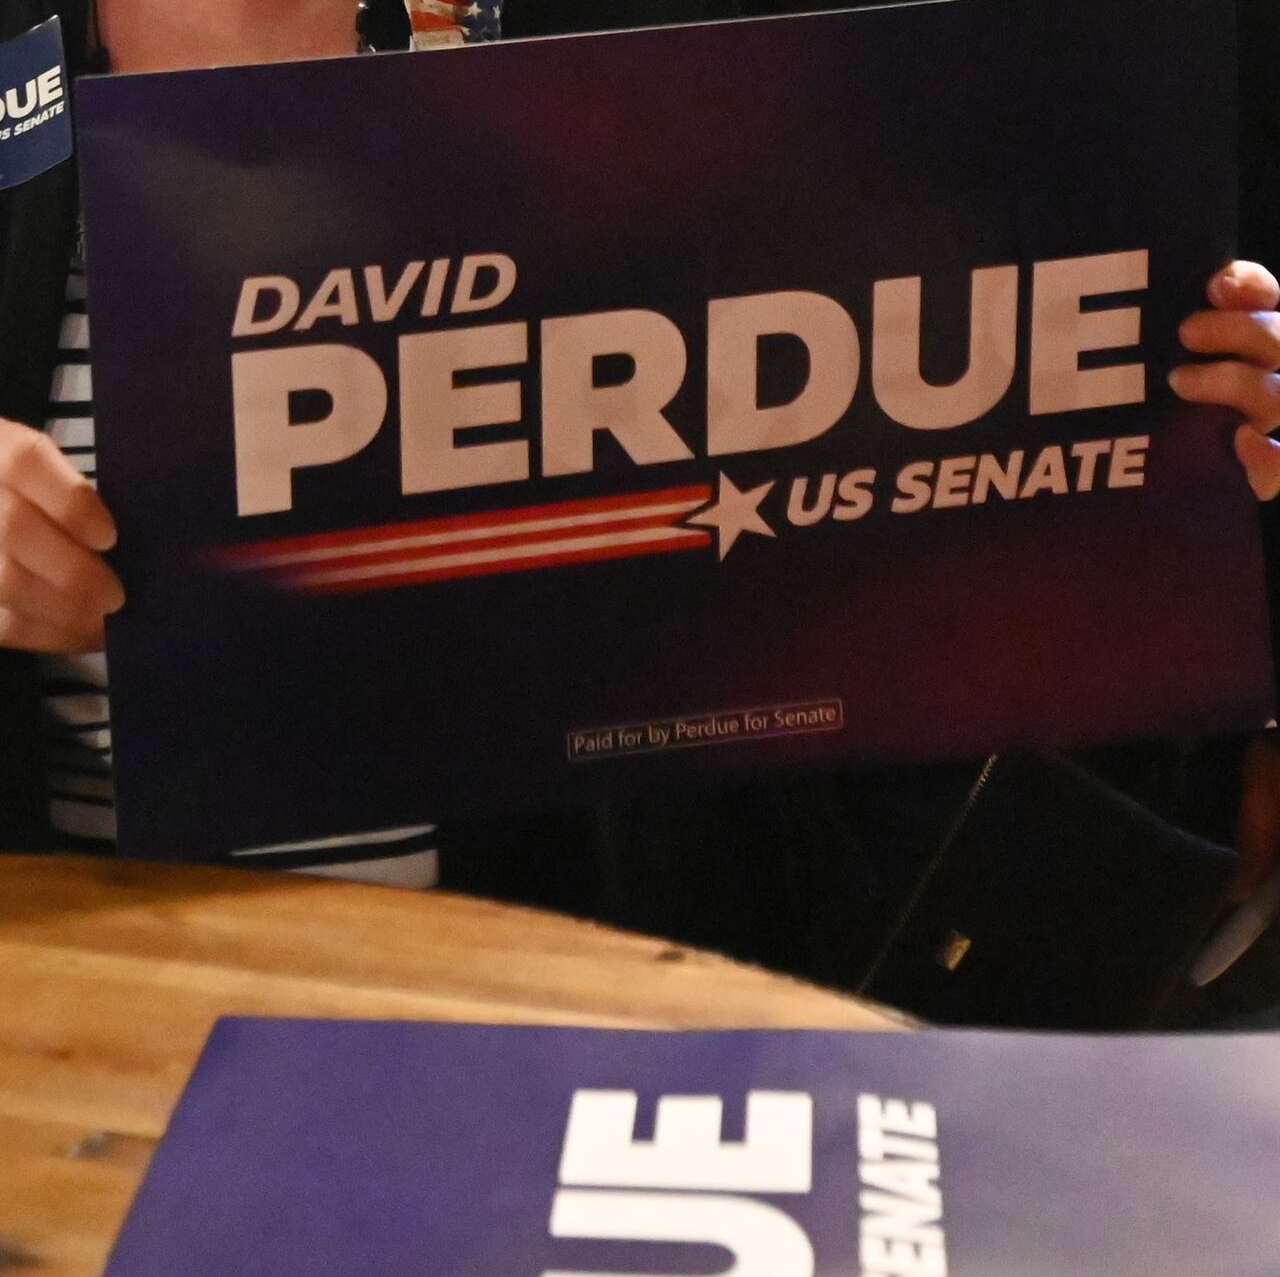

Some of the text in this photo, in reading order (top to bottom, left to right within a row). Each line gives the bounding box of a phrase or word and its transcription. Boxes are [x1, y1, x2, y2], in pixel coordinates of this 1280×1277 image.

[14, 101, 65, 137] SENATE
[231, 253, 517, 337] DAVID
[230, 249, 1149, 517] PERDUE
[786, 435, 1150, 526] US SENATE
[575, 705, 838, 754] Paid for by Perdue for Senate
[858, 1092, 949, 1277] ENATE
